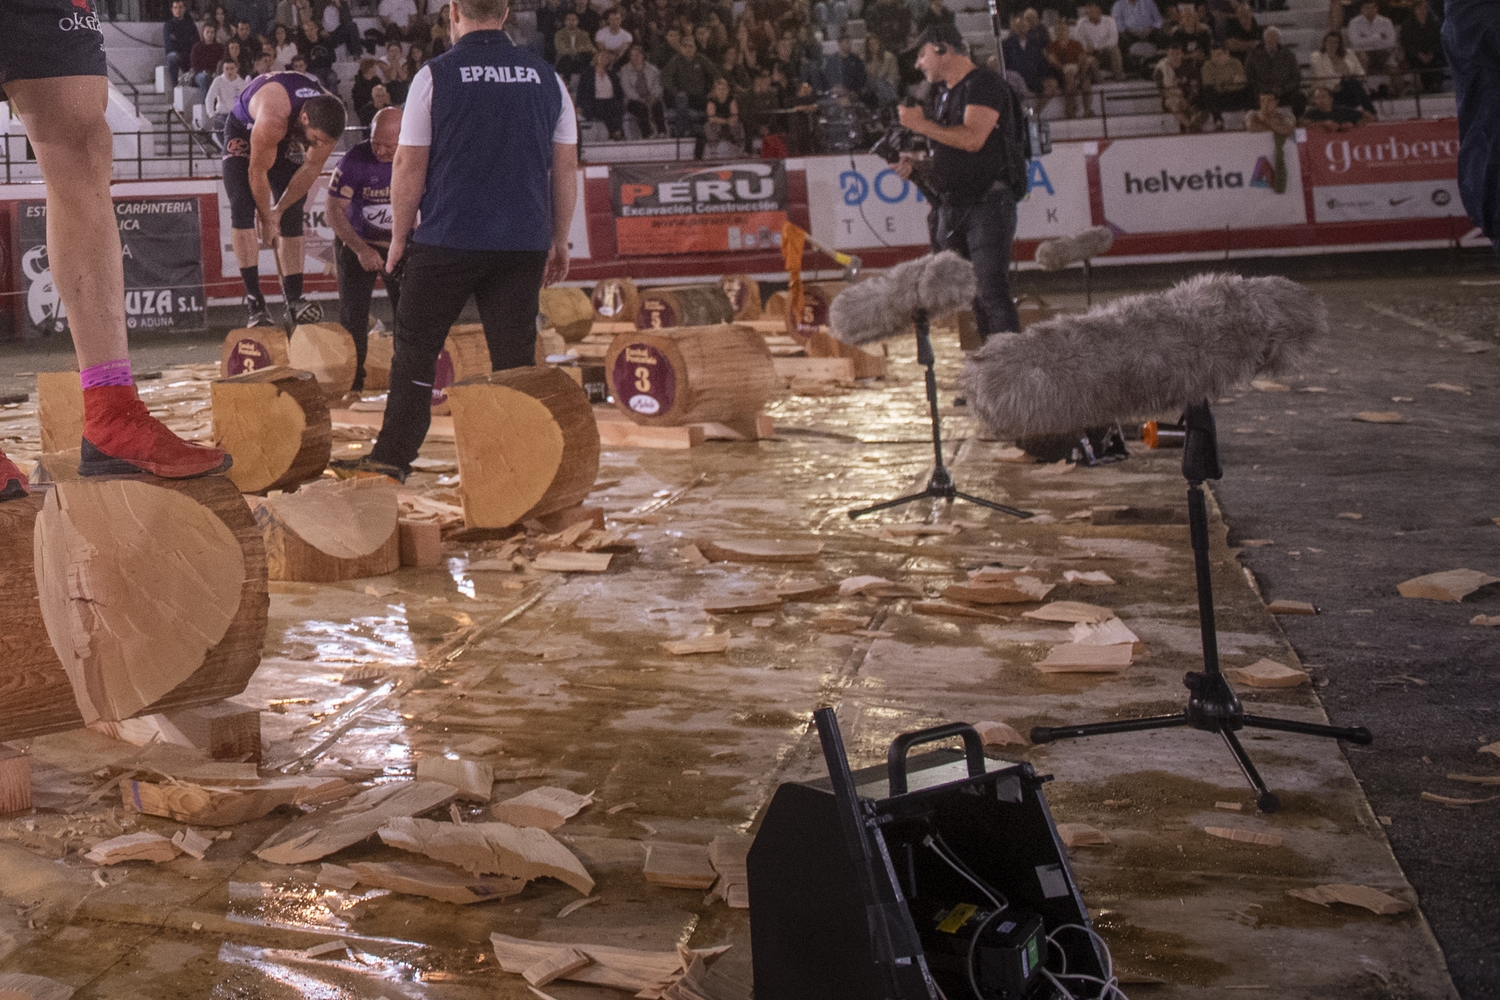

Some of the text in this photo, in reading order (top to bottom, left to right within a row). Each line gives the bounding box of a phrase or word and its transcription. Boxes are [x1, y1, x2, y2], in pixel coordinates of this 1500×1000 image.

[460, 66, 541, 84] EPAILEA
[1124, 165, 1244, 194] helvetia
[621, 178, 775, 205] PERU
[116, 202, 193, 214] CARPINTERIA
[178, 296, 203, 312] S.L.
[140, 317, 174, 327] ADUNA
[634, 367, 651, 392] 3
